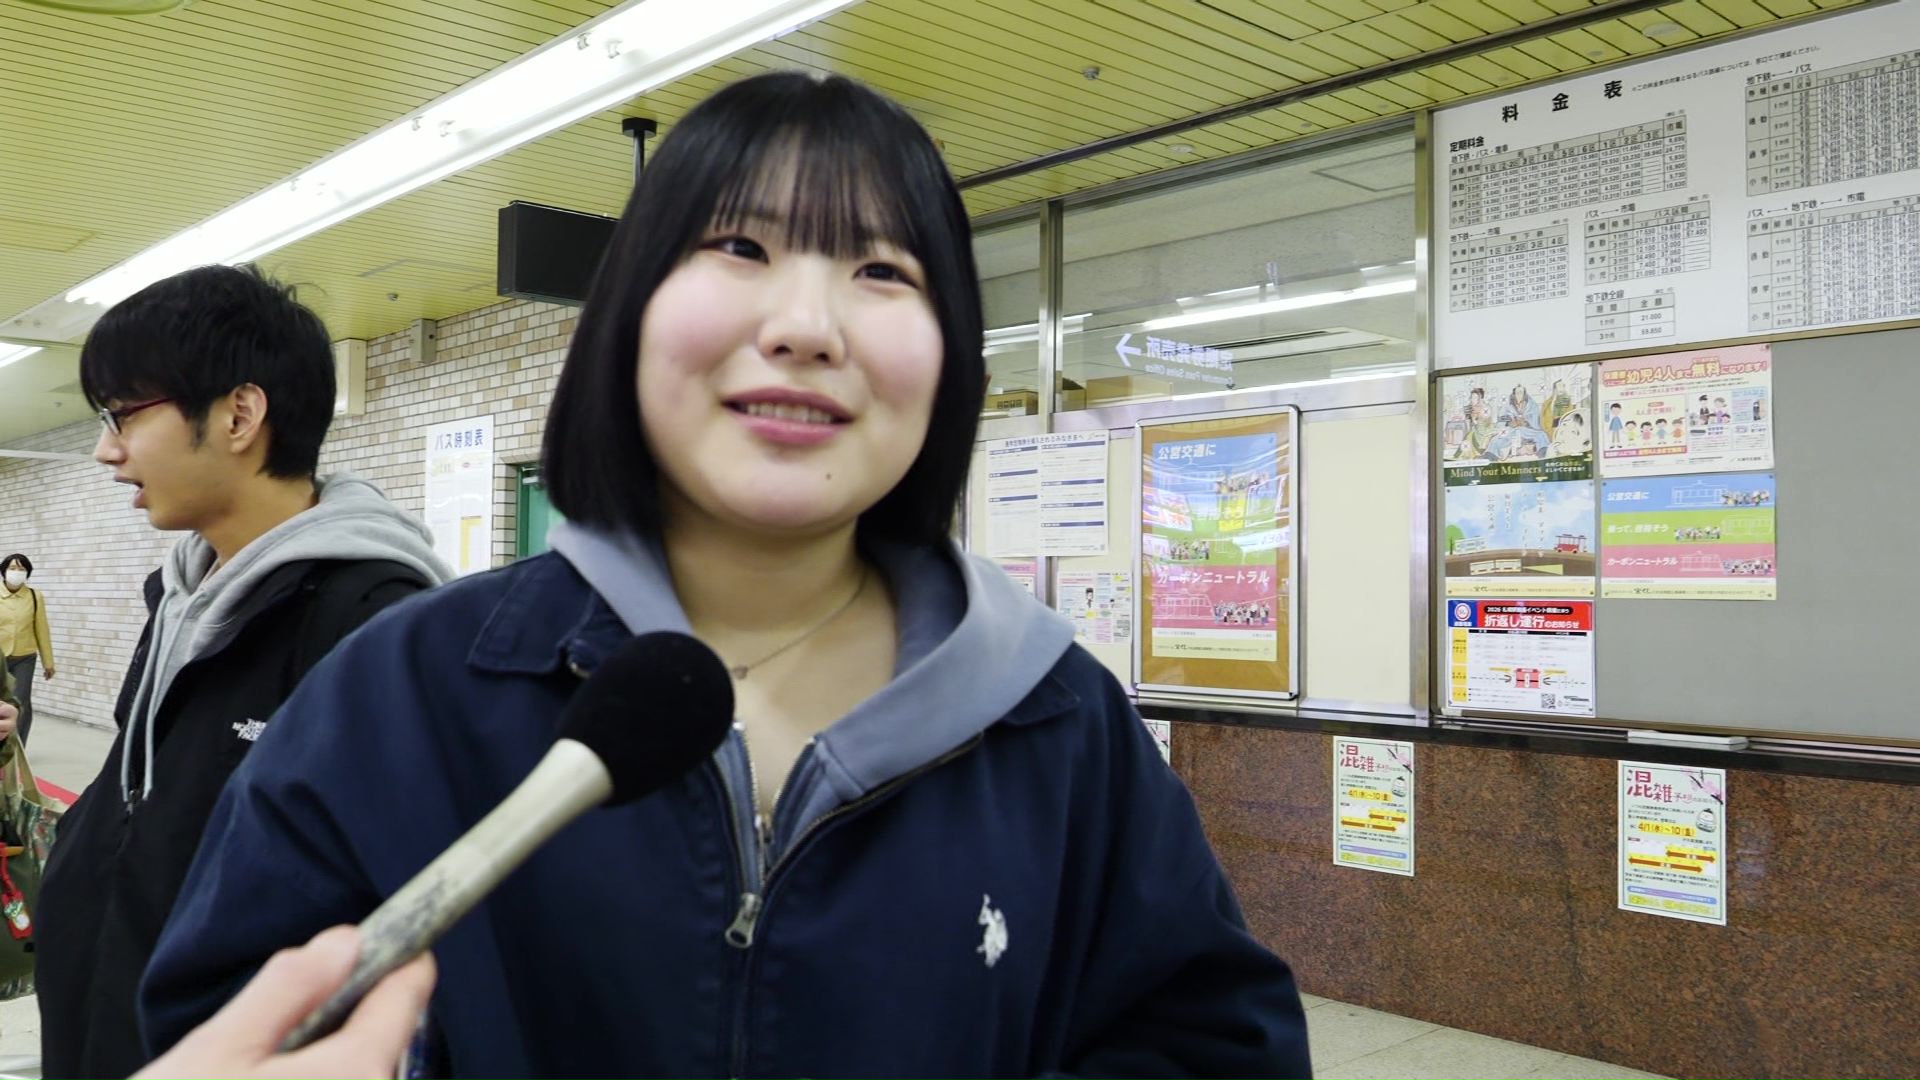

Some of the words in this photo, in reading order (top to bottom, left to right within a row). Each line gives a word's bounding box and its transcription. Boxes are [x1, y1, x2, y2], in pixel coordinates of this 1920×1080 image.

[1795, 64, 1812, 74] バス
[1502, 80, 1622, 122] 料金表
[1450, 135, 1485, 153] 定期料金
[1747, 209, 1763, 218] バス
[435, 428, 483, 450] バス時刻表
[1158, 443, 1216, 460] 公営交通に
[1450, 468, 1474, 478] Mind
[1477, 466, 1498, 477] Your
[1502, 464, 1541, 476] Manners
[1607, 557, 1679, 566] カーボンニュートラル
[1158, 570, 1270, 585] カーボンニュートラル
[1484, 614, 1580, 629] 折返し運行のお知らせ
